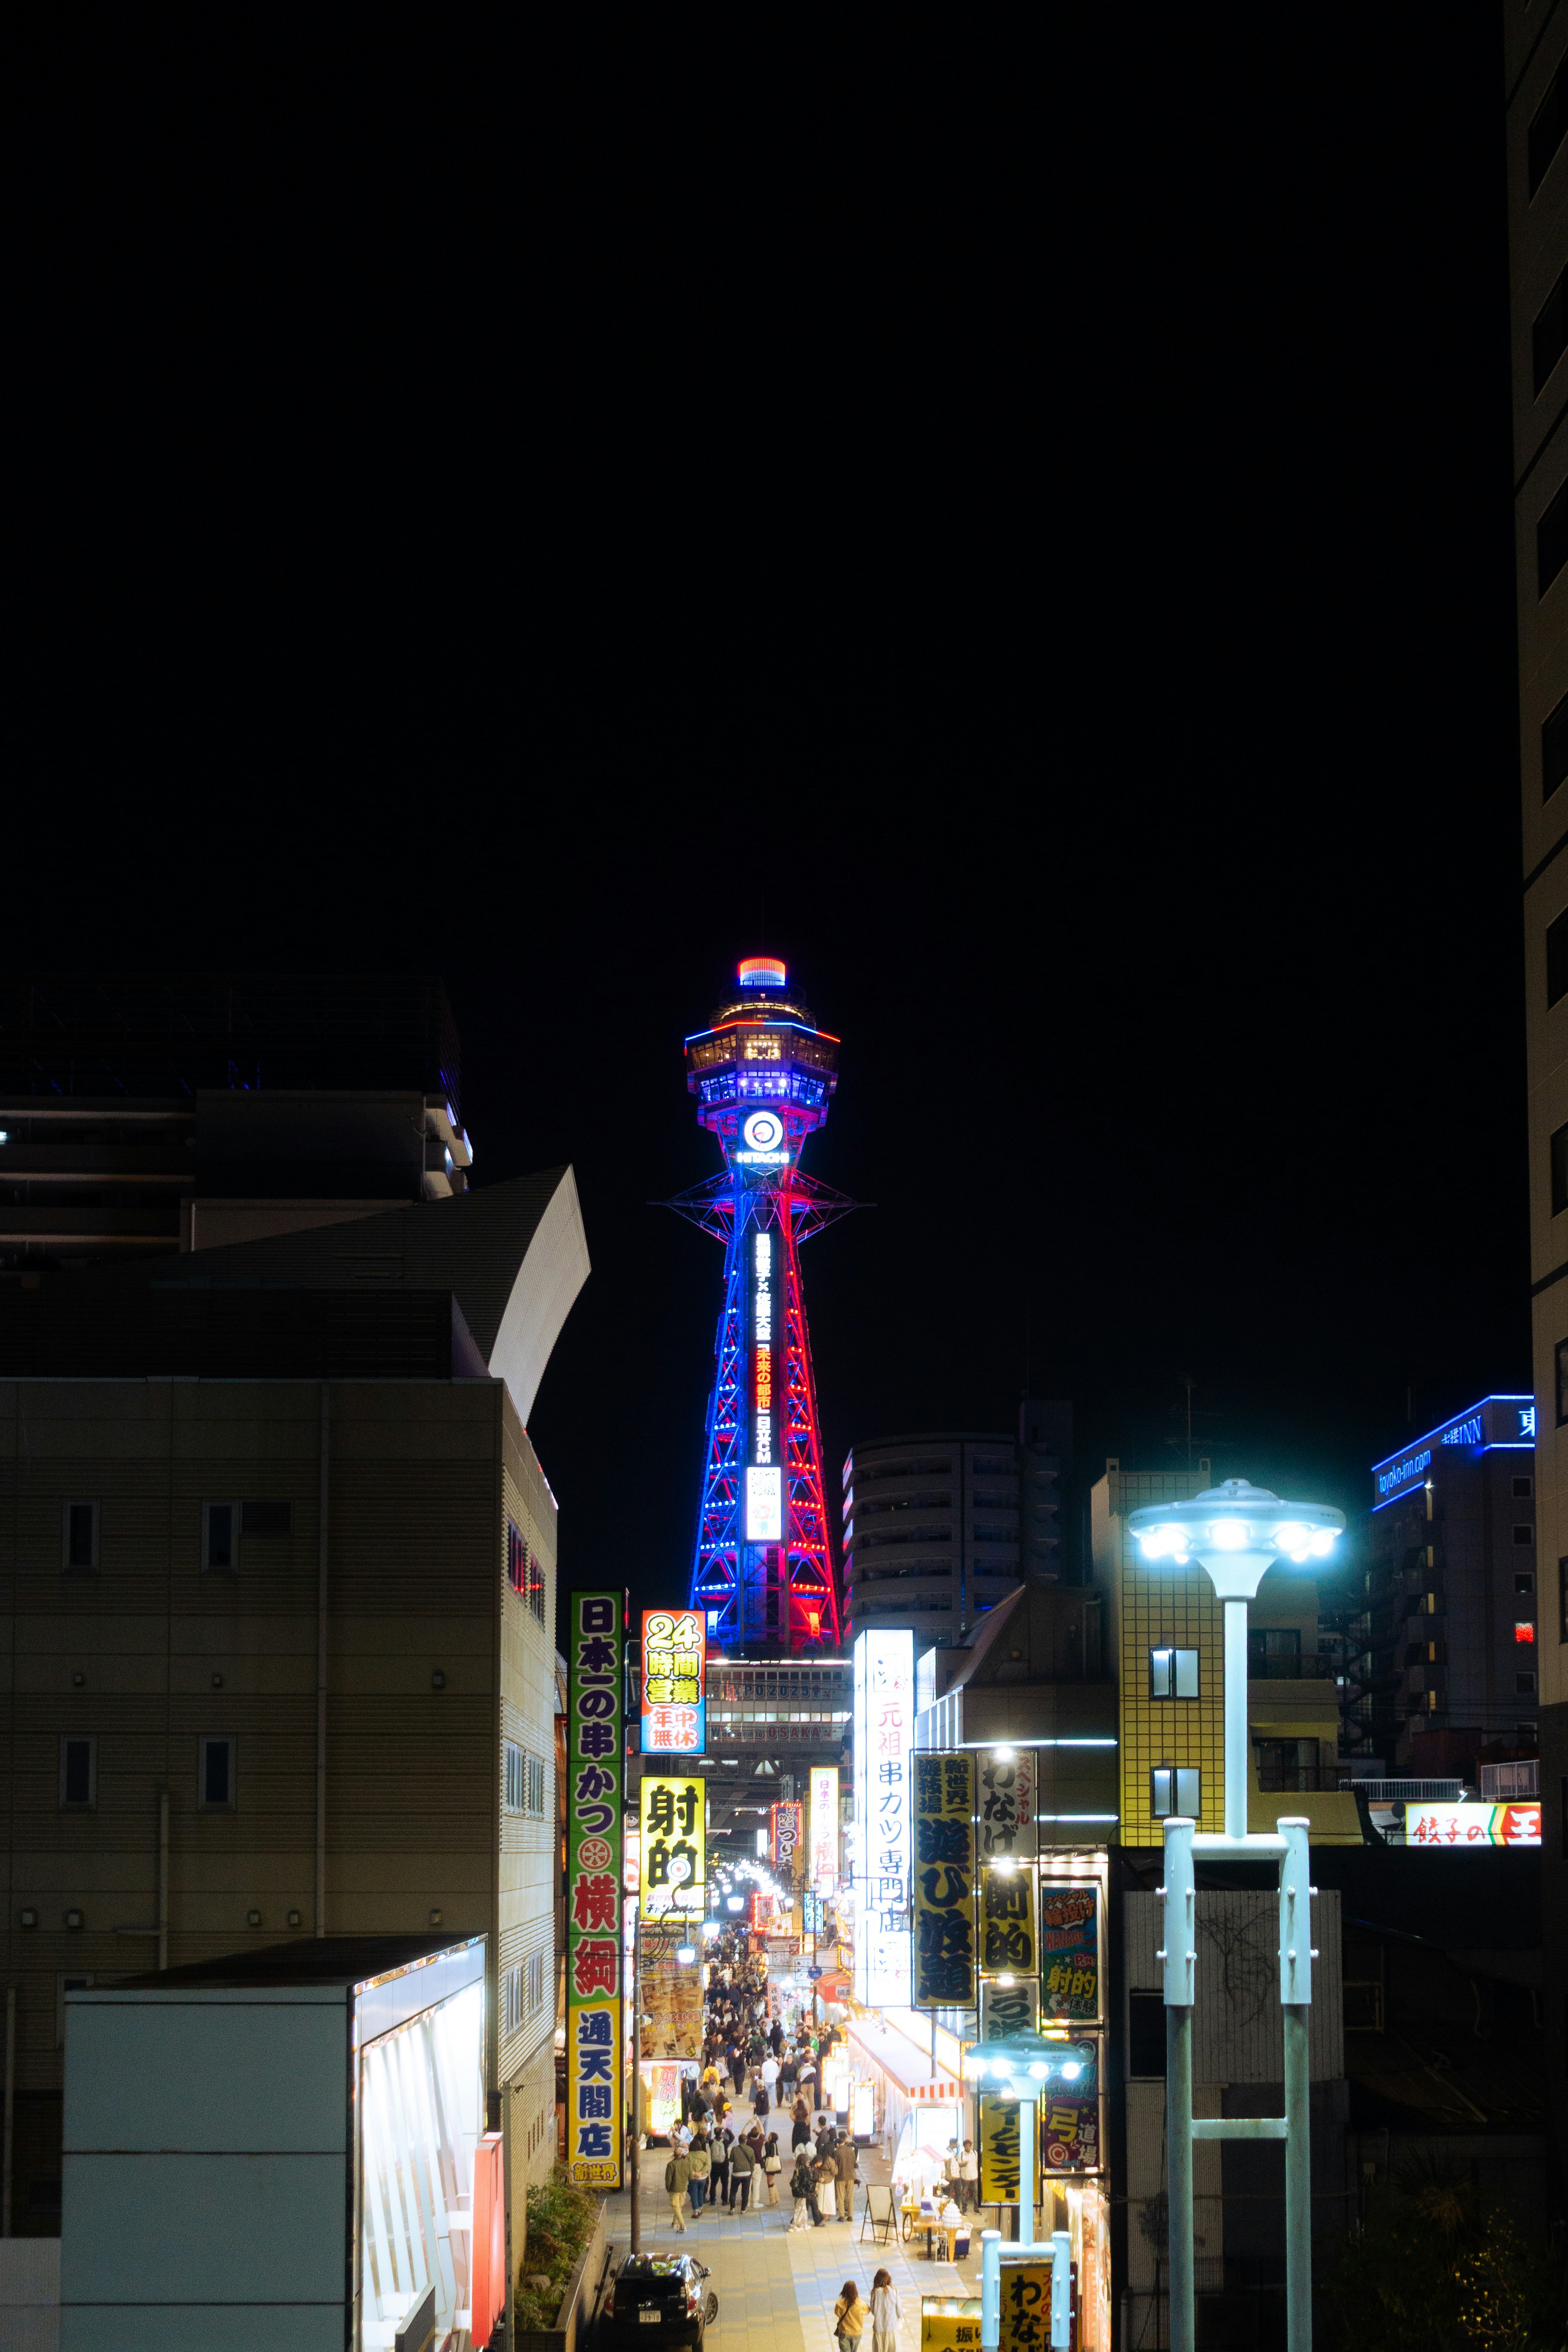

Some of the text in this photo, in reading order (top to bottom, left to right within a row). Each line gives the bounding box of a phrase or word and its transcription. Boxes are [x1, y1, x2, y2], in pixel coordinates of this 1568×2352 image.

[738, 1152, 789, 1163] HITACHI
[1379, 1449, 1431, 1496] toyoko-inn.com
[646, 1614, 702, 1650] 24
[647, 1652, 699, 1676] 時間
[647, 1679, 699, 1704] 営業
[652, 1708, 694, 1726] 年中
[768, 1725, 821, 1738] OSAKA
[652, 1729, 697, 1748] 無休
[983, 1758, 1018, 1855] わなげ
[1016, 1757, 1031, 1825] スペシャル
[878, 1702, 903, 1933] 元祖串カツ専門店
[1413, 1811, 1542, 1844] 餃子の 王
[647, 1784, 698, 1889] 射的
[573, 1597, 617, 2158] 日本一の串かつ 横綱 通天閣店
[918, 1818, 973, 2001] 遊び放題
[986, 1873, 1031, 1968] 射的
[1046, 1965, 1096, 1998] 射的
[1069, 1998, 1096, 2015] 体験
[573, 2163, 616, 2182] 新世界
